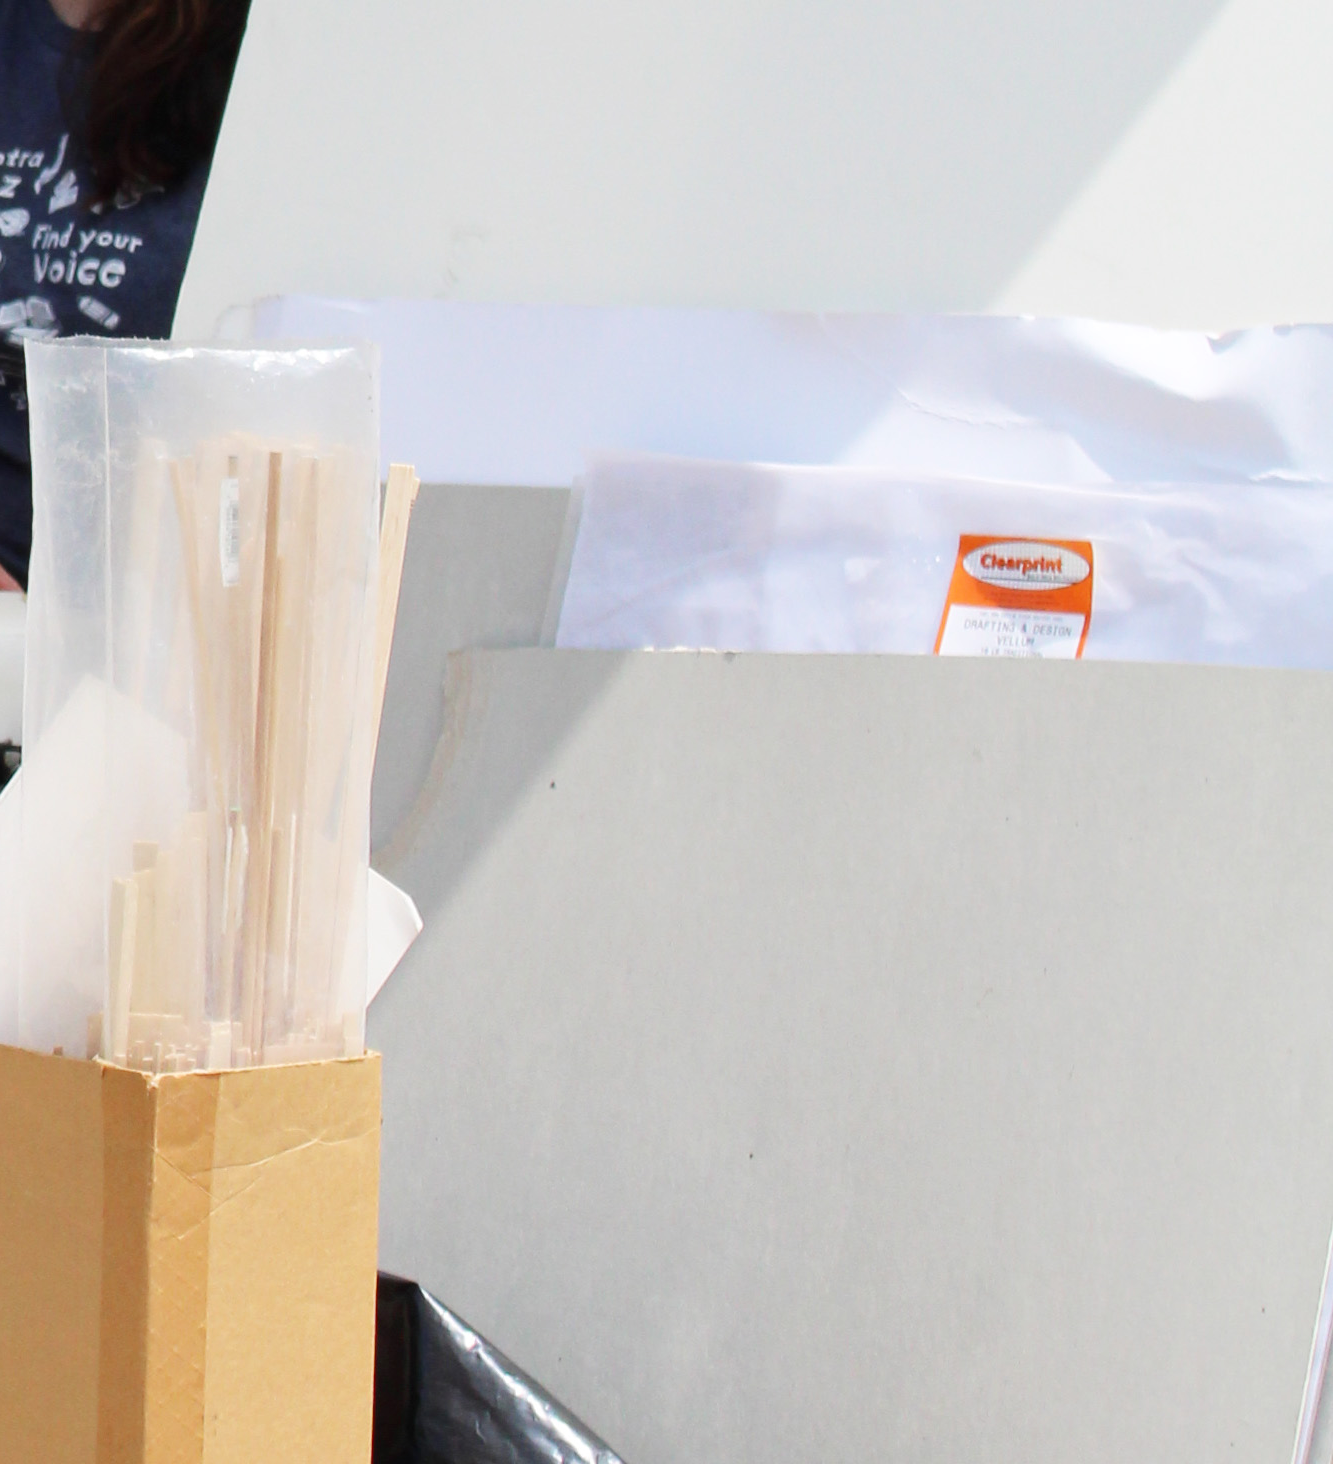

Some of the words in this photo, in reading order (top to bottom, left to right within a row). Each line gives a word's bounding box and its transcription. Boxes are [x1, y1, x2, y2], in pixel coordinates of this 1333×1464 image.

[32, 223, 74, 250] Find
[79, 230, 143, 253] your
[33, 250, 126, 288] Voice
[980, 553, 1062, 576] Clearprint
[964, 619, 1015, 634] DRAFTING
[1033, 624, 1073, 637] DESIGN
[997, 635, 1035, 648] VELLUM
